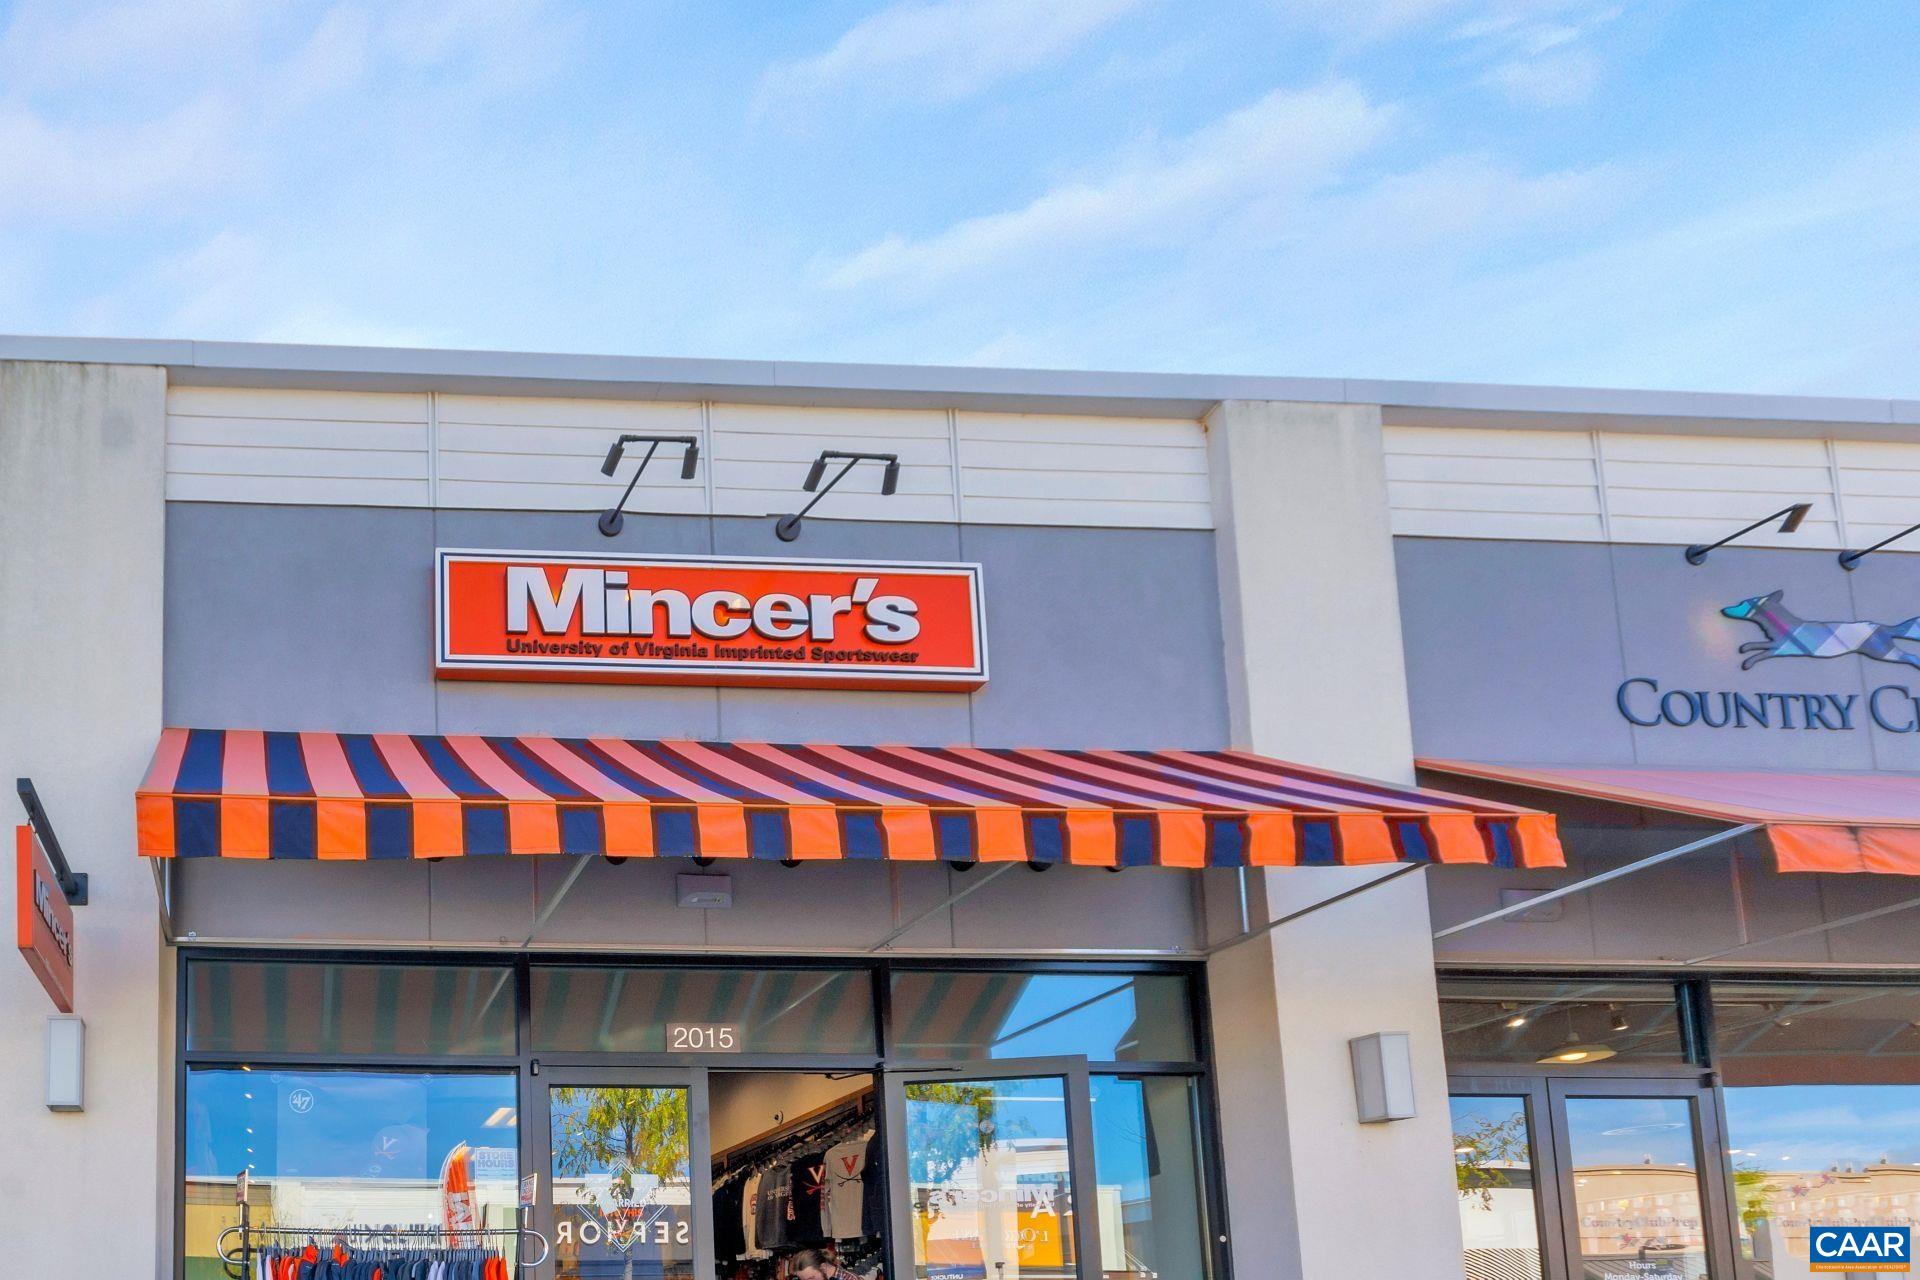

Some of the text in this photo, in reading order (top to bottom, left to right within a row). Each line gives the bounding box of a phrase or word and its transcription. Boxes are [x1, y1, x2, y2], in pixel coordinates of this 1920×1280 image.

[506, 566, 921, 643] Mincer's
[506, 638, 919, 663] University of Virginia Imprinted Sportswear
[673, 1027, 734, 1049] 2015
[479, 1151, 513, 1160] STORE
[478, 1160, 514, 1168] HOURS
[1629, 1261, 1657, 1269] Hours
